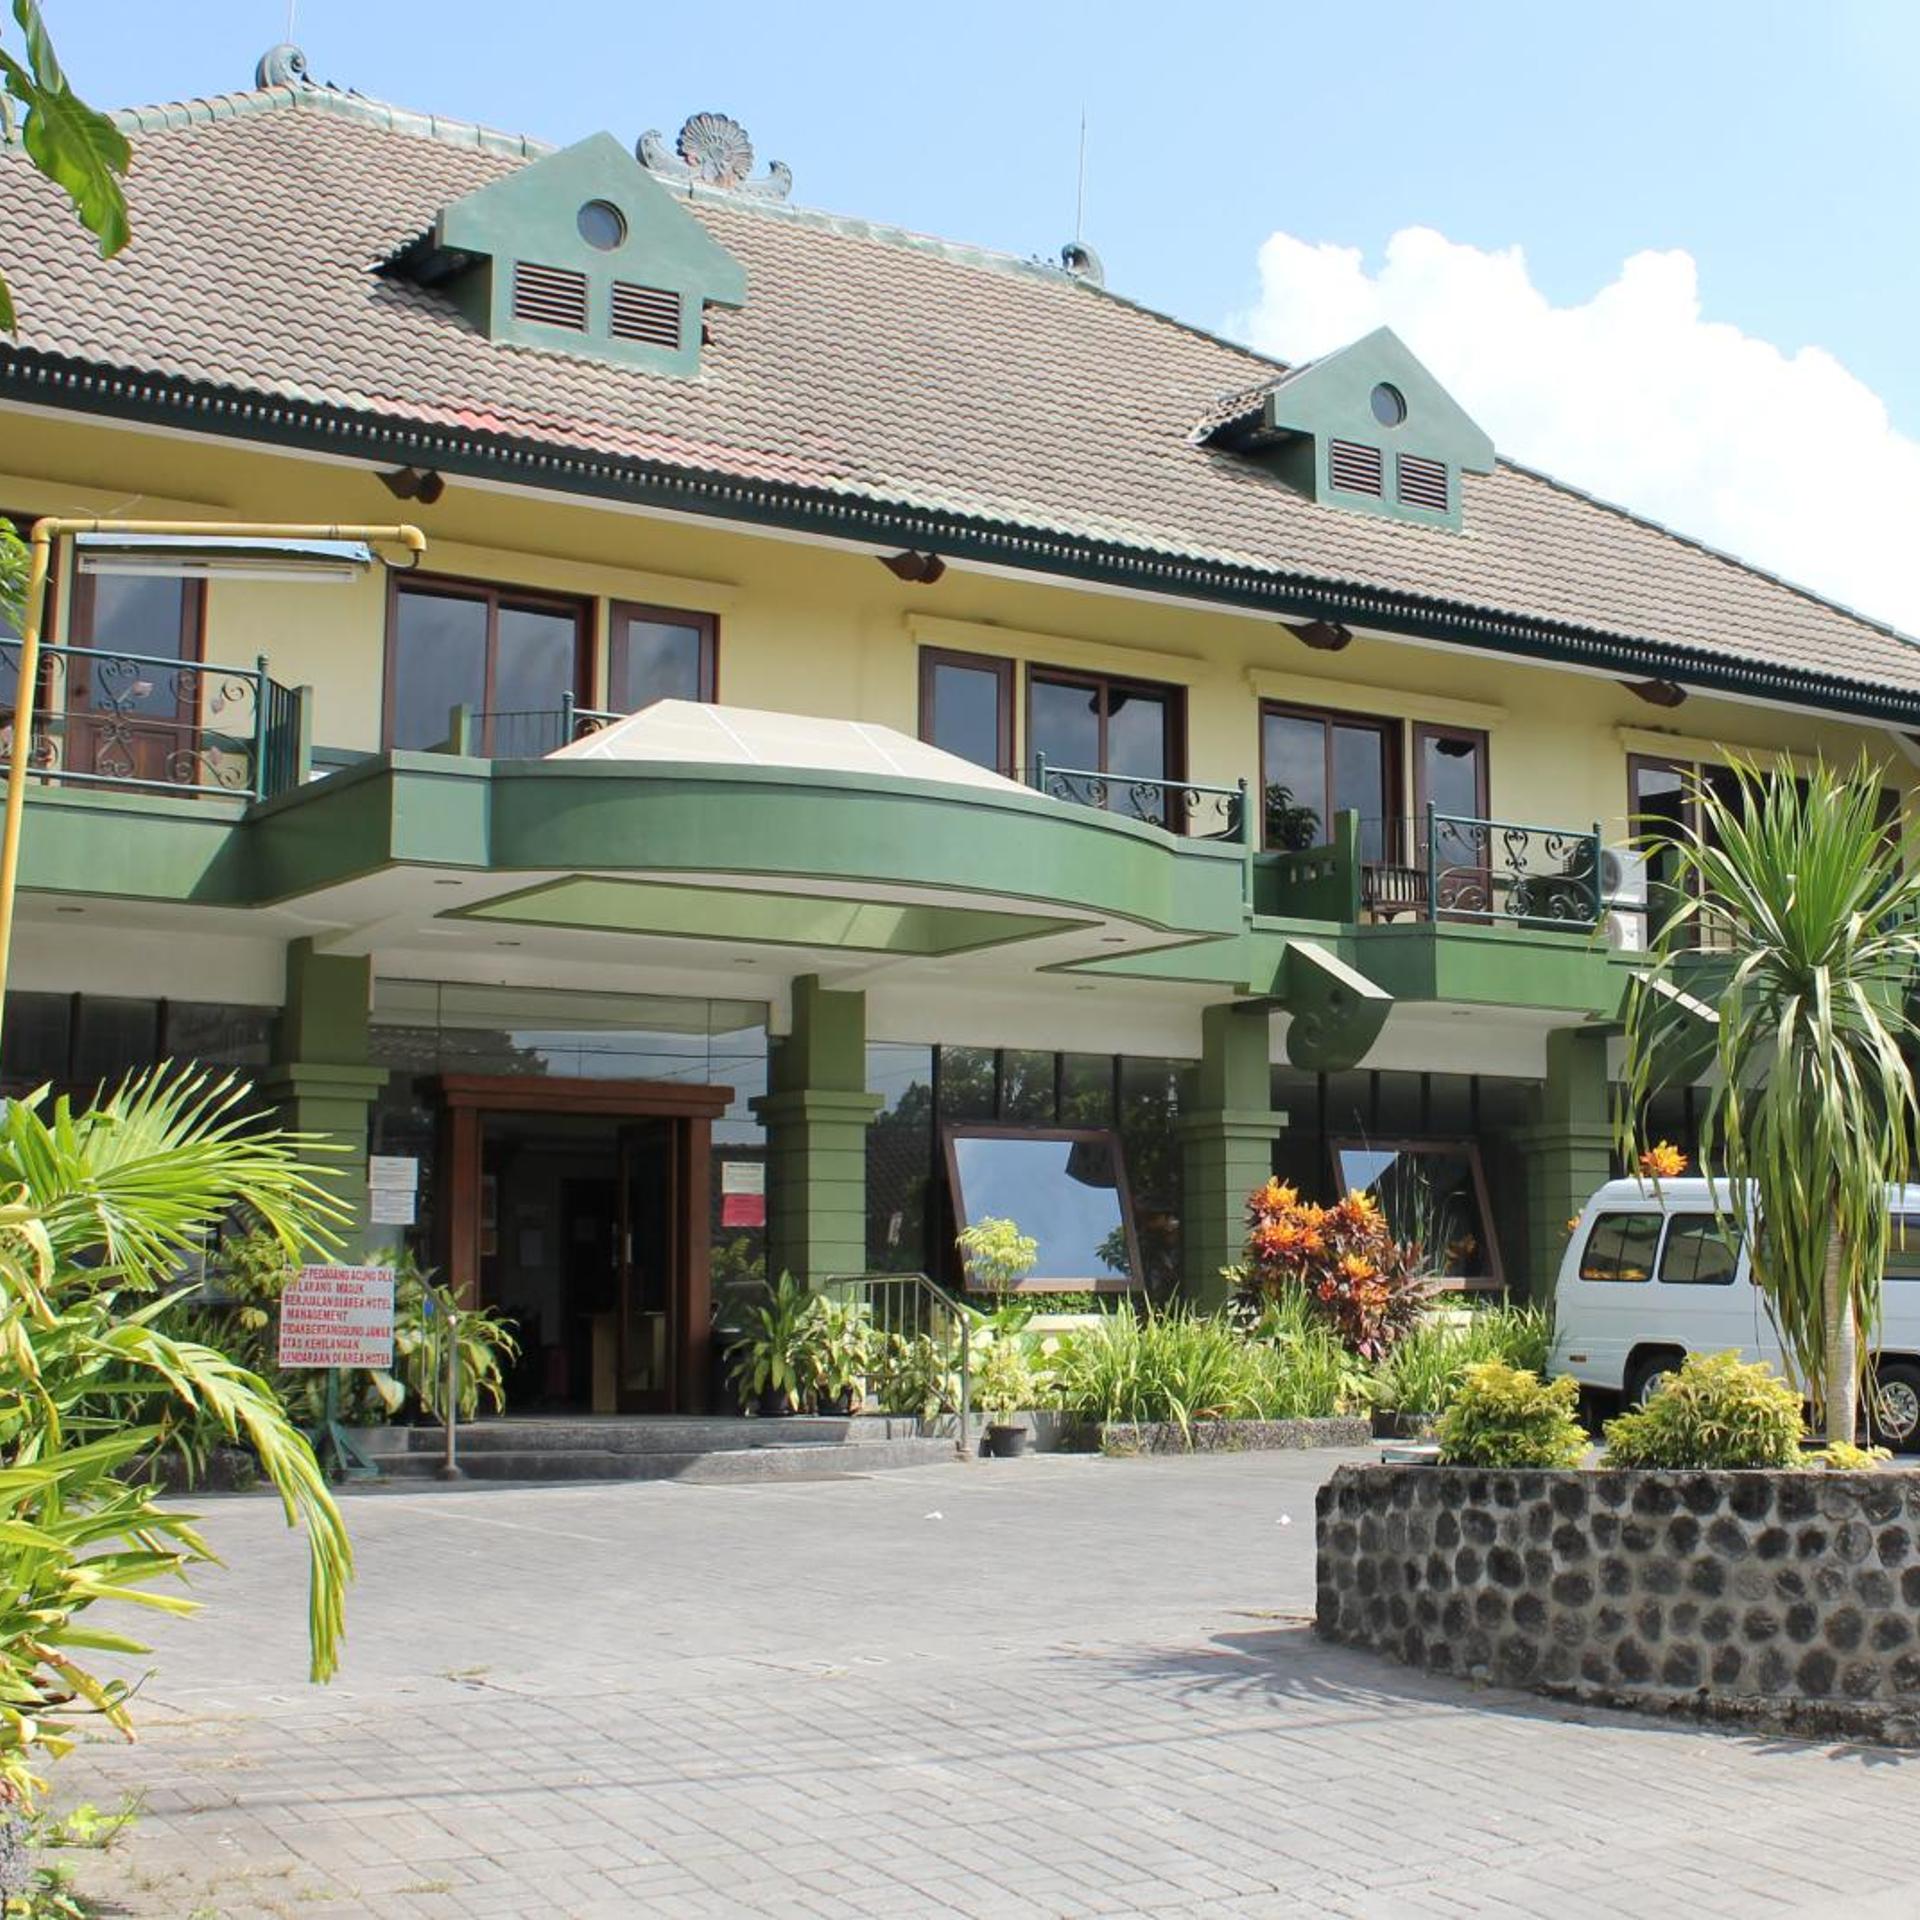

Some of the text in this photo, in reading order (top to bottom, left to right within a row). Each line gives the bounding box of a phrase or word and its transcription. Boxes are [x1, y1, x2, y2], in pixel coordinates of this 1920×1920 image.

[284, 1294, 333, 1307] BERJUALAN
[366, 1298, 391, 1309] HOTEL
[286, 1310, 349, 1321] MANAGEMENT
[342, 1353, 364, 1364] AREA
[365, 1353, 391, 1365] HOTEL
